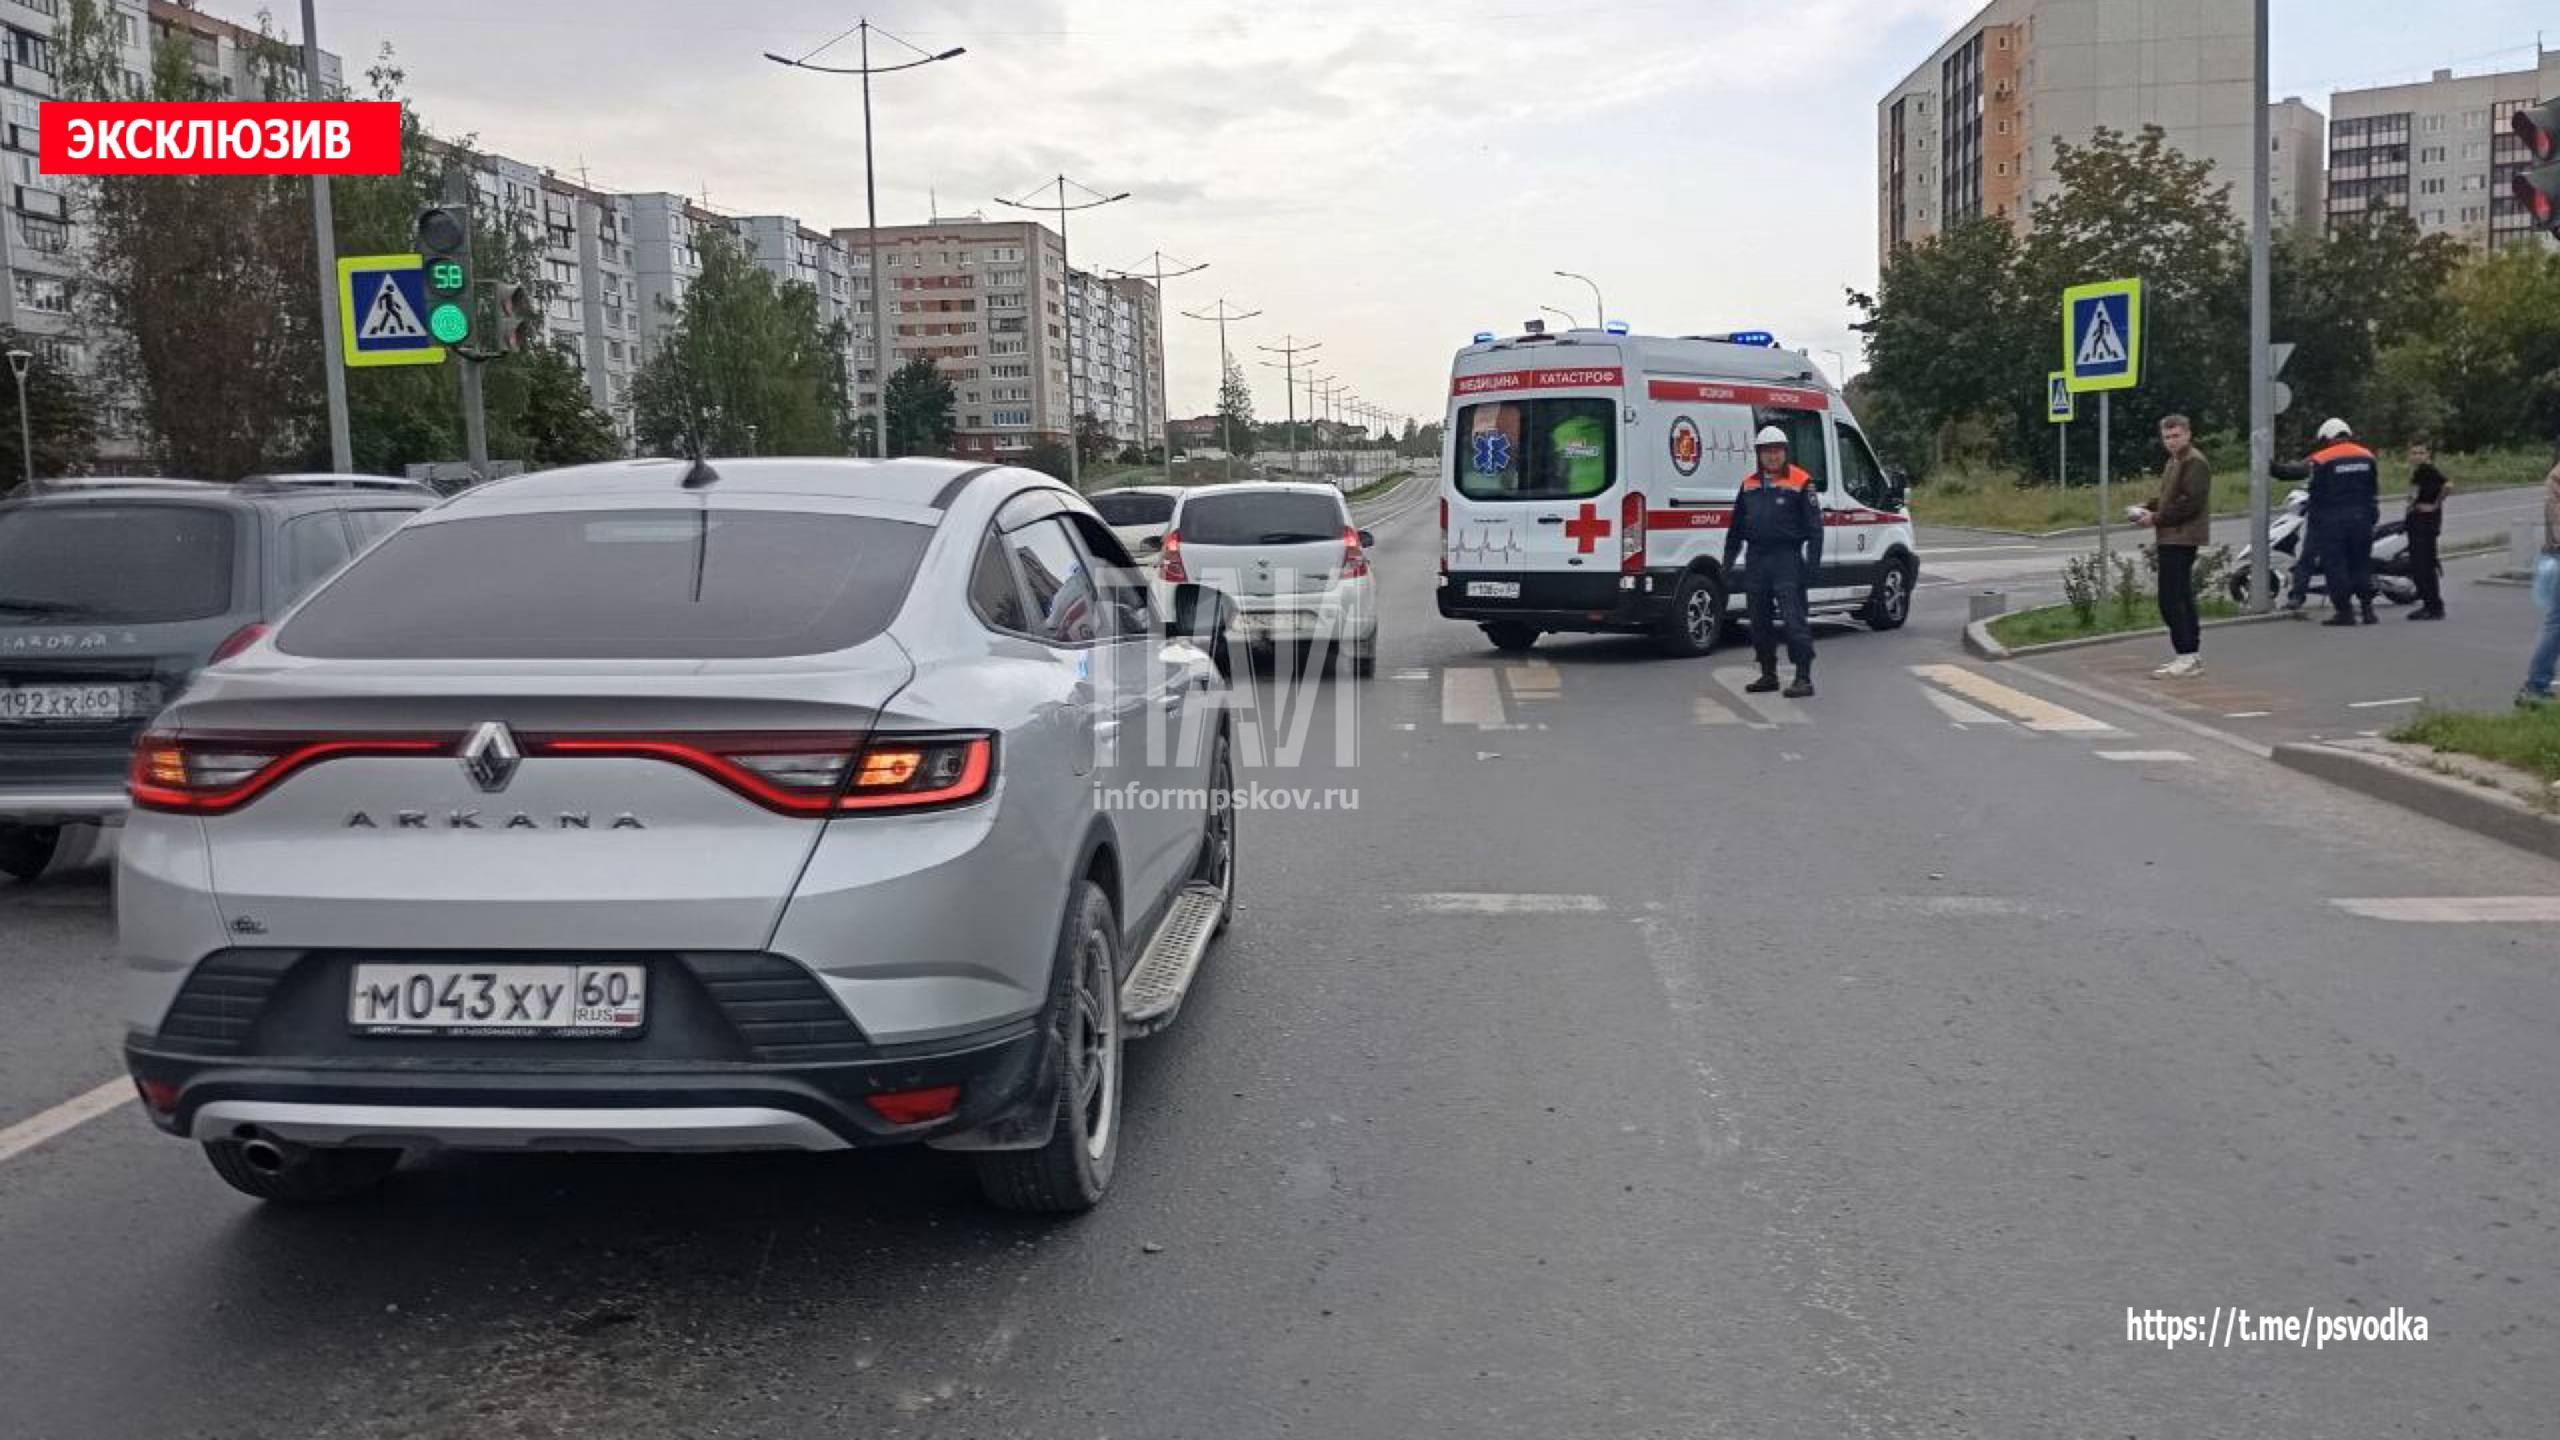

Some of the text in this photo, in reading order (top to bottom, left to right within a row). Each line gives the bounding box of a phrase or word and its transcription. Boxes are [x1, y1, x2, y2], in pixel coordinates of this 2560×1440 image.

[433, 264, 463, 289] 58
[1539, 370, 1615, 385] КАТАСТРОФ
[347, 809, 646, 830] ARKANA
[581, 971, 630, 1008] 60
[576, 1007, 613, 1022] RUS
